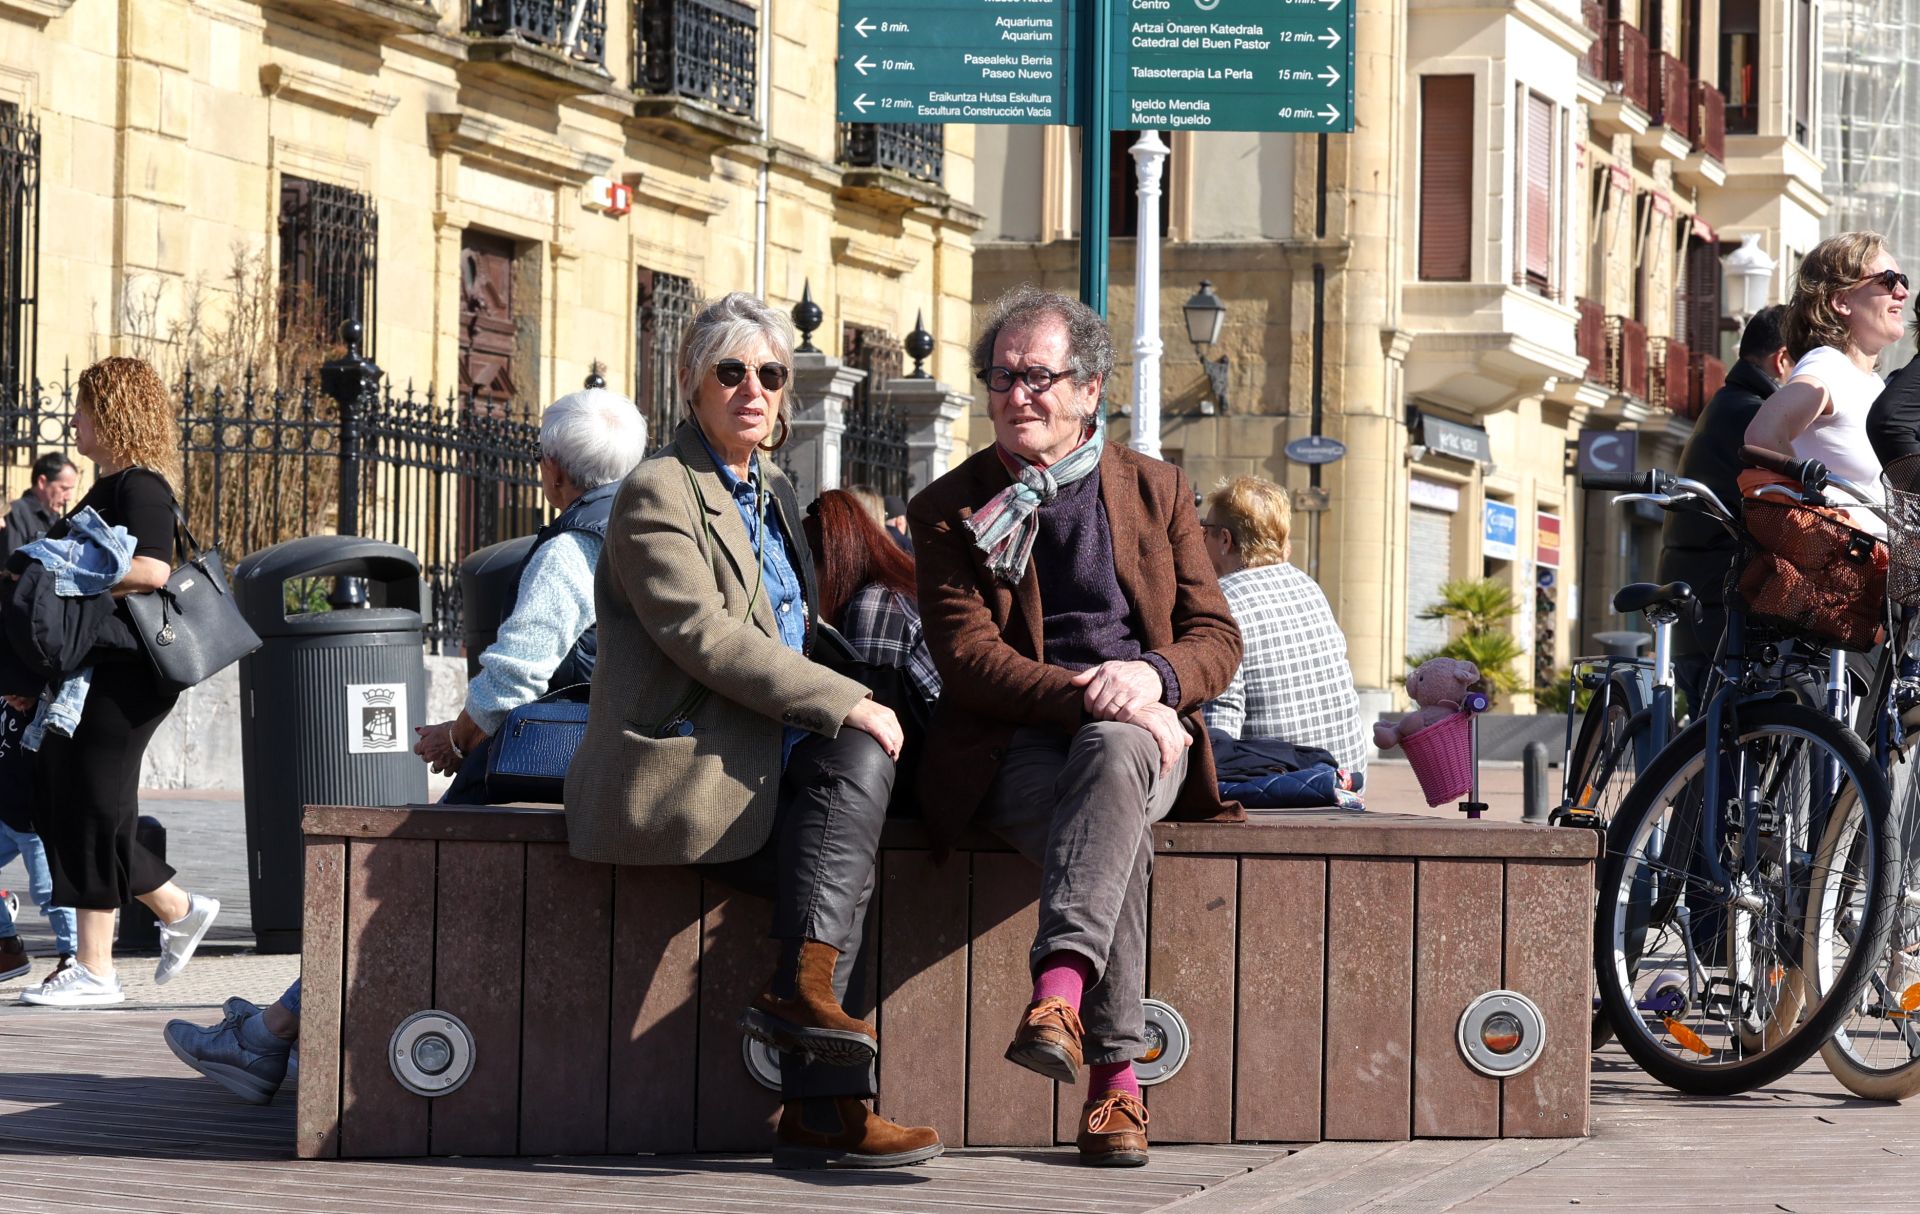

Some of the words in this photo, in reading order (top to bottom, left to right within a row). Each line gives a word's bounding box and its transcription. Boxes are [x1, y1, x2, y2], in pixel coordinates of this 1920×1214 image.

[1132, 0, 1171, 10] Centro
[881, 22, 888, 32] 8
[889, 22, 909, 32] min.
[995, 16, 1053, 28] Aquariuma
[1132, 22, 1164, 33] Artzai
[1167, 23, 1207, 34] Onaren
[1210, 24, 1263, 35] Katedrala
[1001, 30, 1053, 42] Aquarium
[1280, 32, 1292, 42] 12
[1293, 32, 1315, 42] min.
[1132, 37, 1179, 48] Catedral
[1182, 38, 1199, 48] del
[1202, 38, 1231, 49] Buen
[1234, 39, 1271, 50] Pastor
[882, 60, 893, 70] 10
[894, 60, 915, 70] min.
[964, 54, 1018, 65] Pasealeku
[1021, 55, 1053, 65] Berria
[982, 68, 1015, 79] Paseo
[1018, 69, 1053, 80] Nuevo
[1132, 66, 1205, 80] Talasoterapia
[1208, 68, 1222, 78] La
[1225, 68, 1254, 79] Perla
[1279, 69, 1291, 80] 15
[1292, 69, 1314, 80] min.
[881, 98, 893, 108] 12
[893, 98, 914, 108] min.
[929, 91, 977, 102] Eraikuntza
[980, 93, 1007, 103] Hutsa
[1009, 93, 1052, 103] Eskultura
[1132, 98, 1166, 111] Igeldo
[1169, 100, 1210, 110] Mendia
[918, 105, 960, 116] Escultura
[963, 106, 1024, 117] Construcción
[1027, 107, 1052, 117] Vacía
[1279, 108, 1292, 118] 40
[1293, 108, 1315, 118] min.
[1132, 113, 1167, 125] Monte
[1170, 114, 1211, 126] Igueldo
